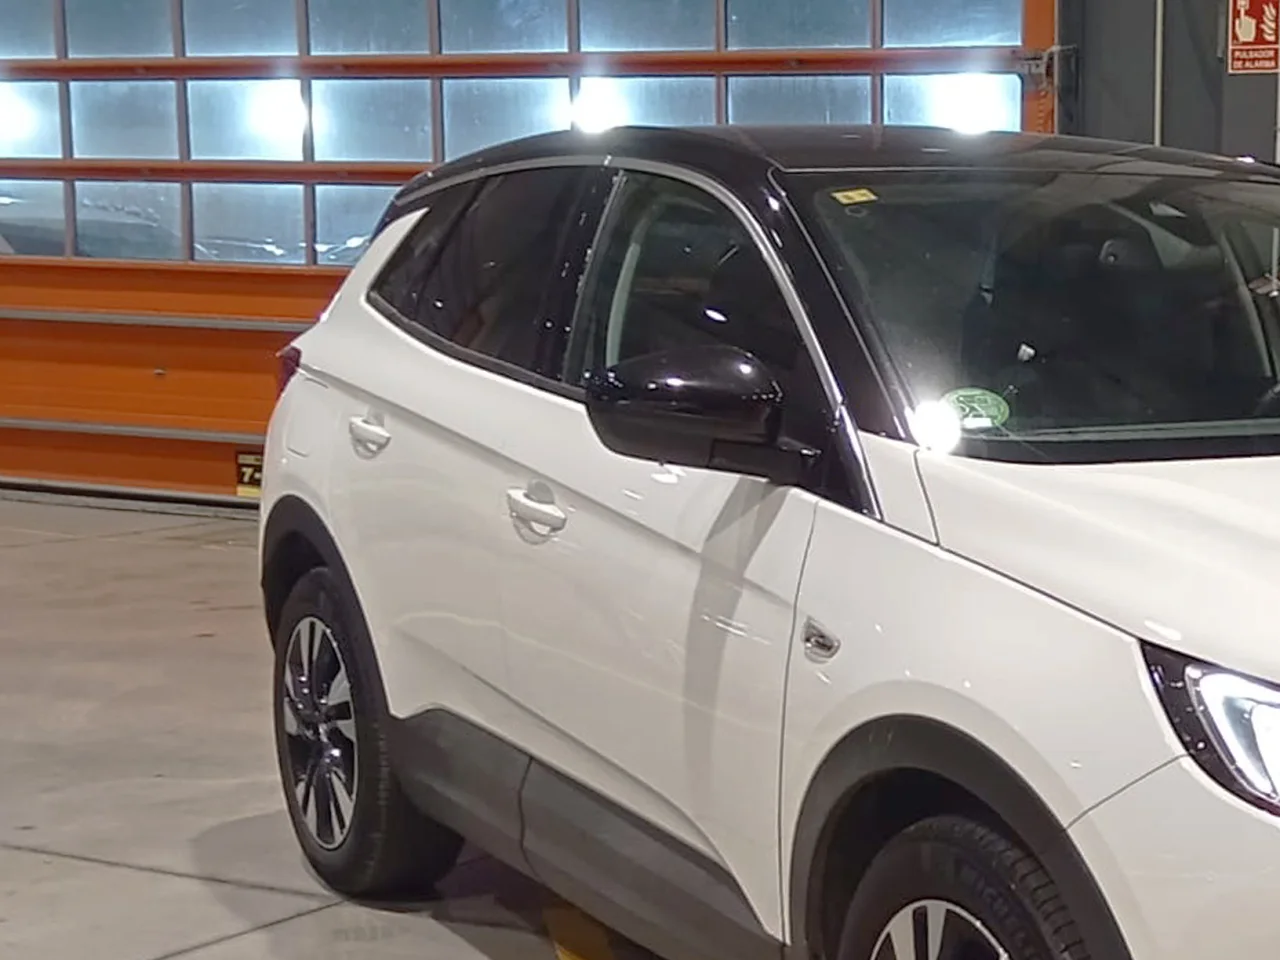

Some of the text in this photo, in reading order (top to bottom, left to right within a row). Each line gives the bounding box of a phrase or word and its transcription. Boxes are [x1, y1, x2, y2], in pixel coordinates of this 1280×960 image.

[1234, 50, 1275, 58] PULSADOR
[1233, 60, 1276, 68] DE ALARMA
